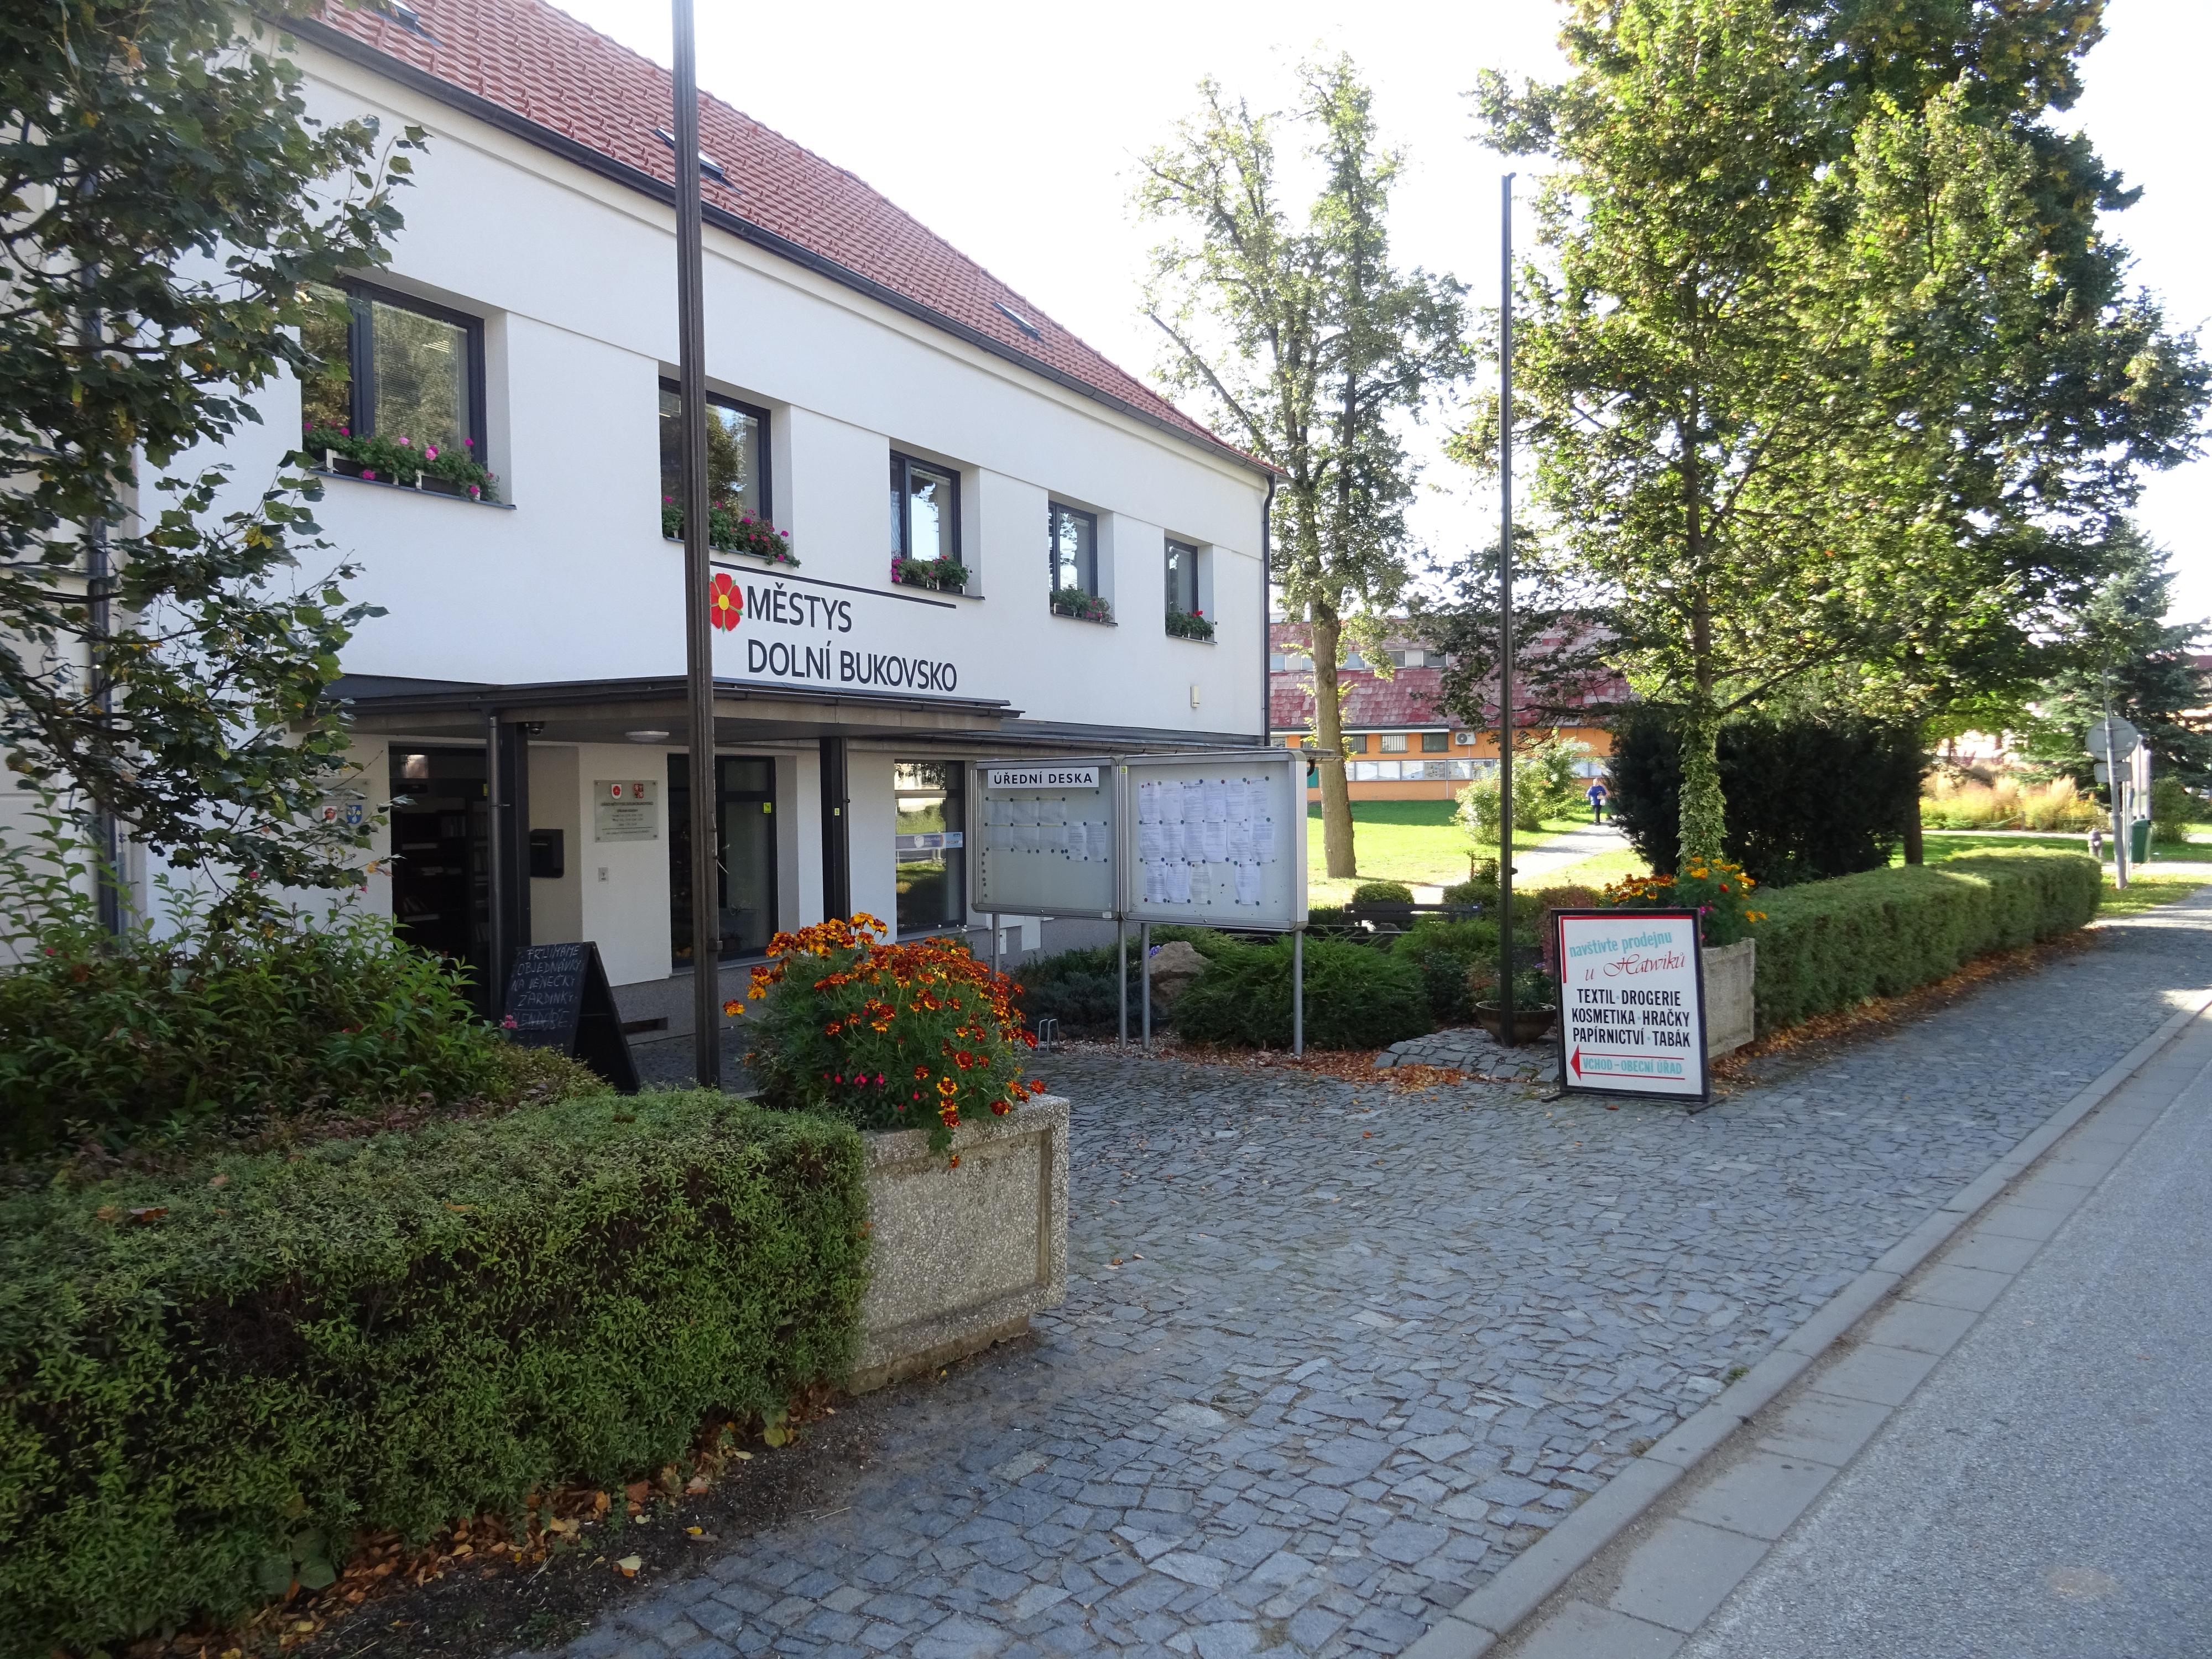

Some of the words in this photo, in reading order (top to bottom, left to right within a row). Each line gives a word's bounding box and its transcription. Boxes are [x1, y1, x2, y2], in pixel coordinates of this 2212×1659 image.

[748, 582, 852, 633] MĚSTYS
[748, 639, 831, 680] DOLNÍ
[841, 650, 957, 692] BUKOVSKO
[994, 771, 1042, 784] ÚŘEDNÍ
[1048, 773, 1092, 784] DESKA
[1622, 931, 1672, 953] prodejnu
[1577, 989, 1615, 1004] TEXTIL
[1621, 990, 1681, 1006] DROGERIE
[1572, 1008, 1635, 1025] KOSMETIKA
[1642, 1009, 1690, 1027] HRAČKY
[1573, 1026, 1645, 1045] PAPÍRNICTVÍ
[1652, 1030, 1691, 1047] TABÁK
[1583, 1058, 1613, 1070] VCHOD
